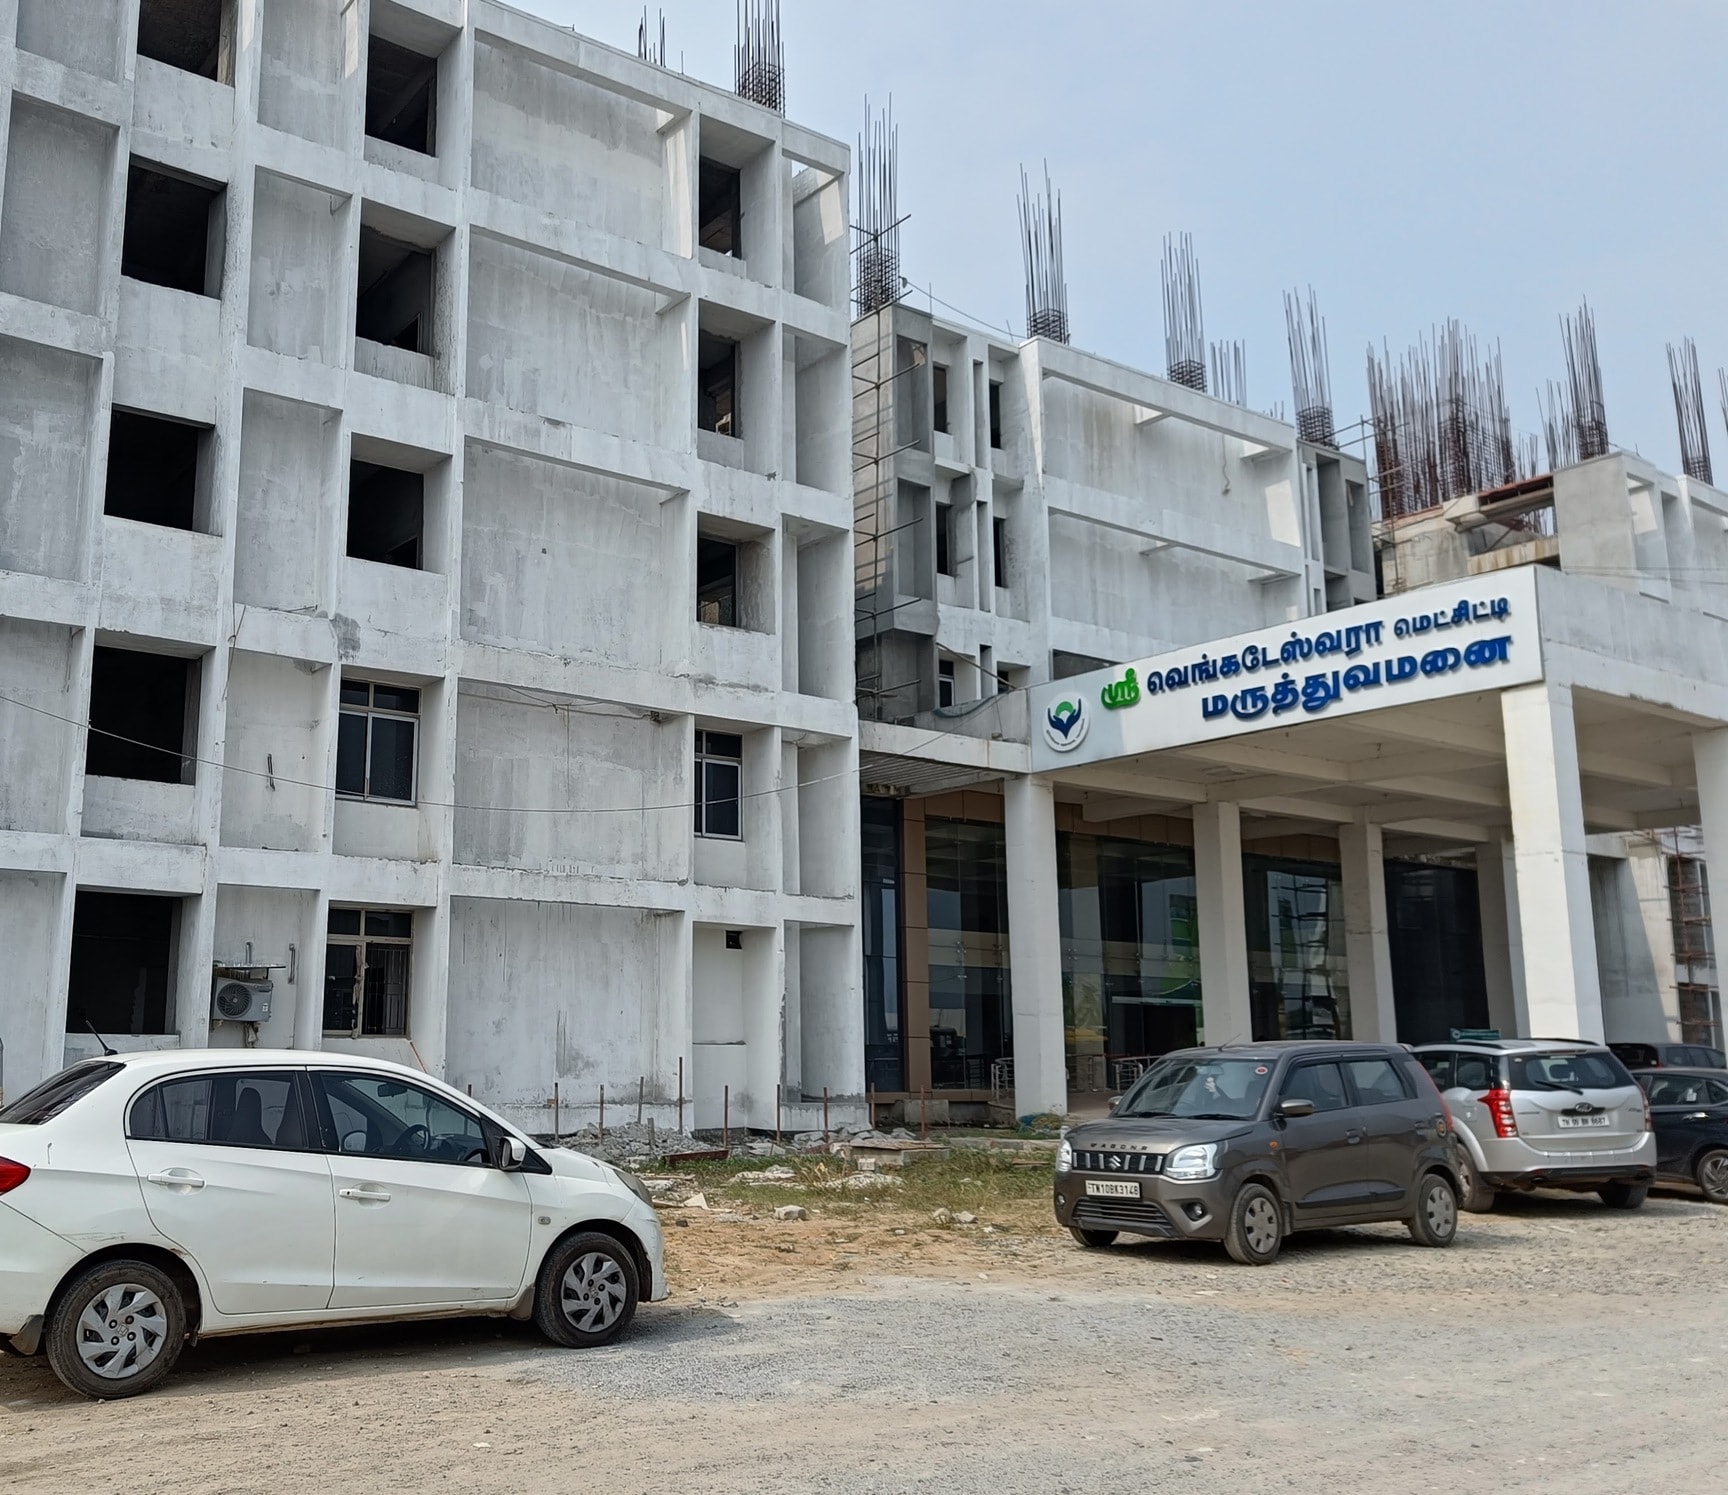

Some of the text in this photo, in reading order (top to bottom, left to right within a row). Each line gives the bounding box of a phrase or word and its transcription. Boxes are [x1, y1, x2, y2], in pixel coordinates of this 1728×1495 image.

[1101, 597, 1510, 710] ஸ்ரீ வெங்கடேஸ்வரா மெட்சிட்டி
[1202, 635, 1512, 718] மருத்துவமனை
